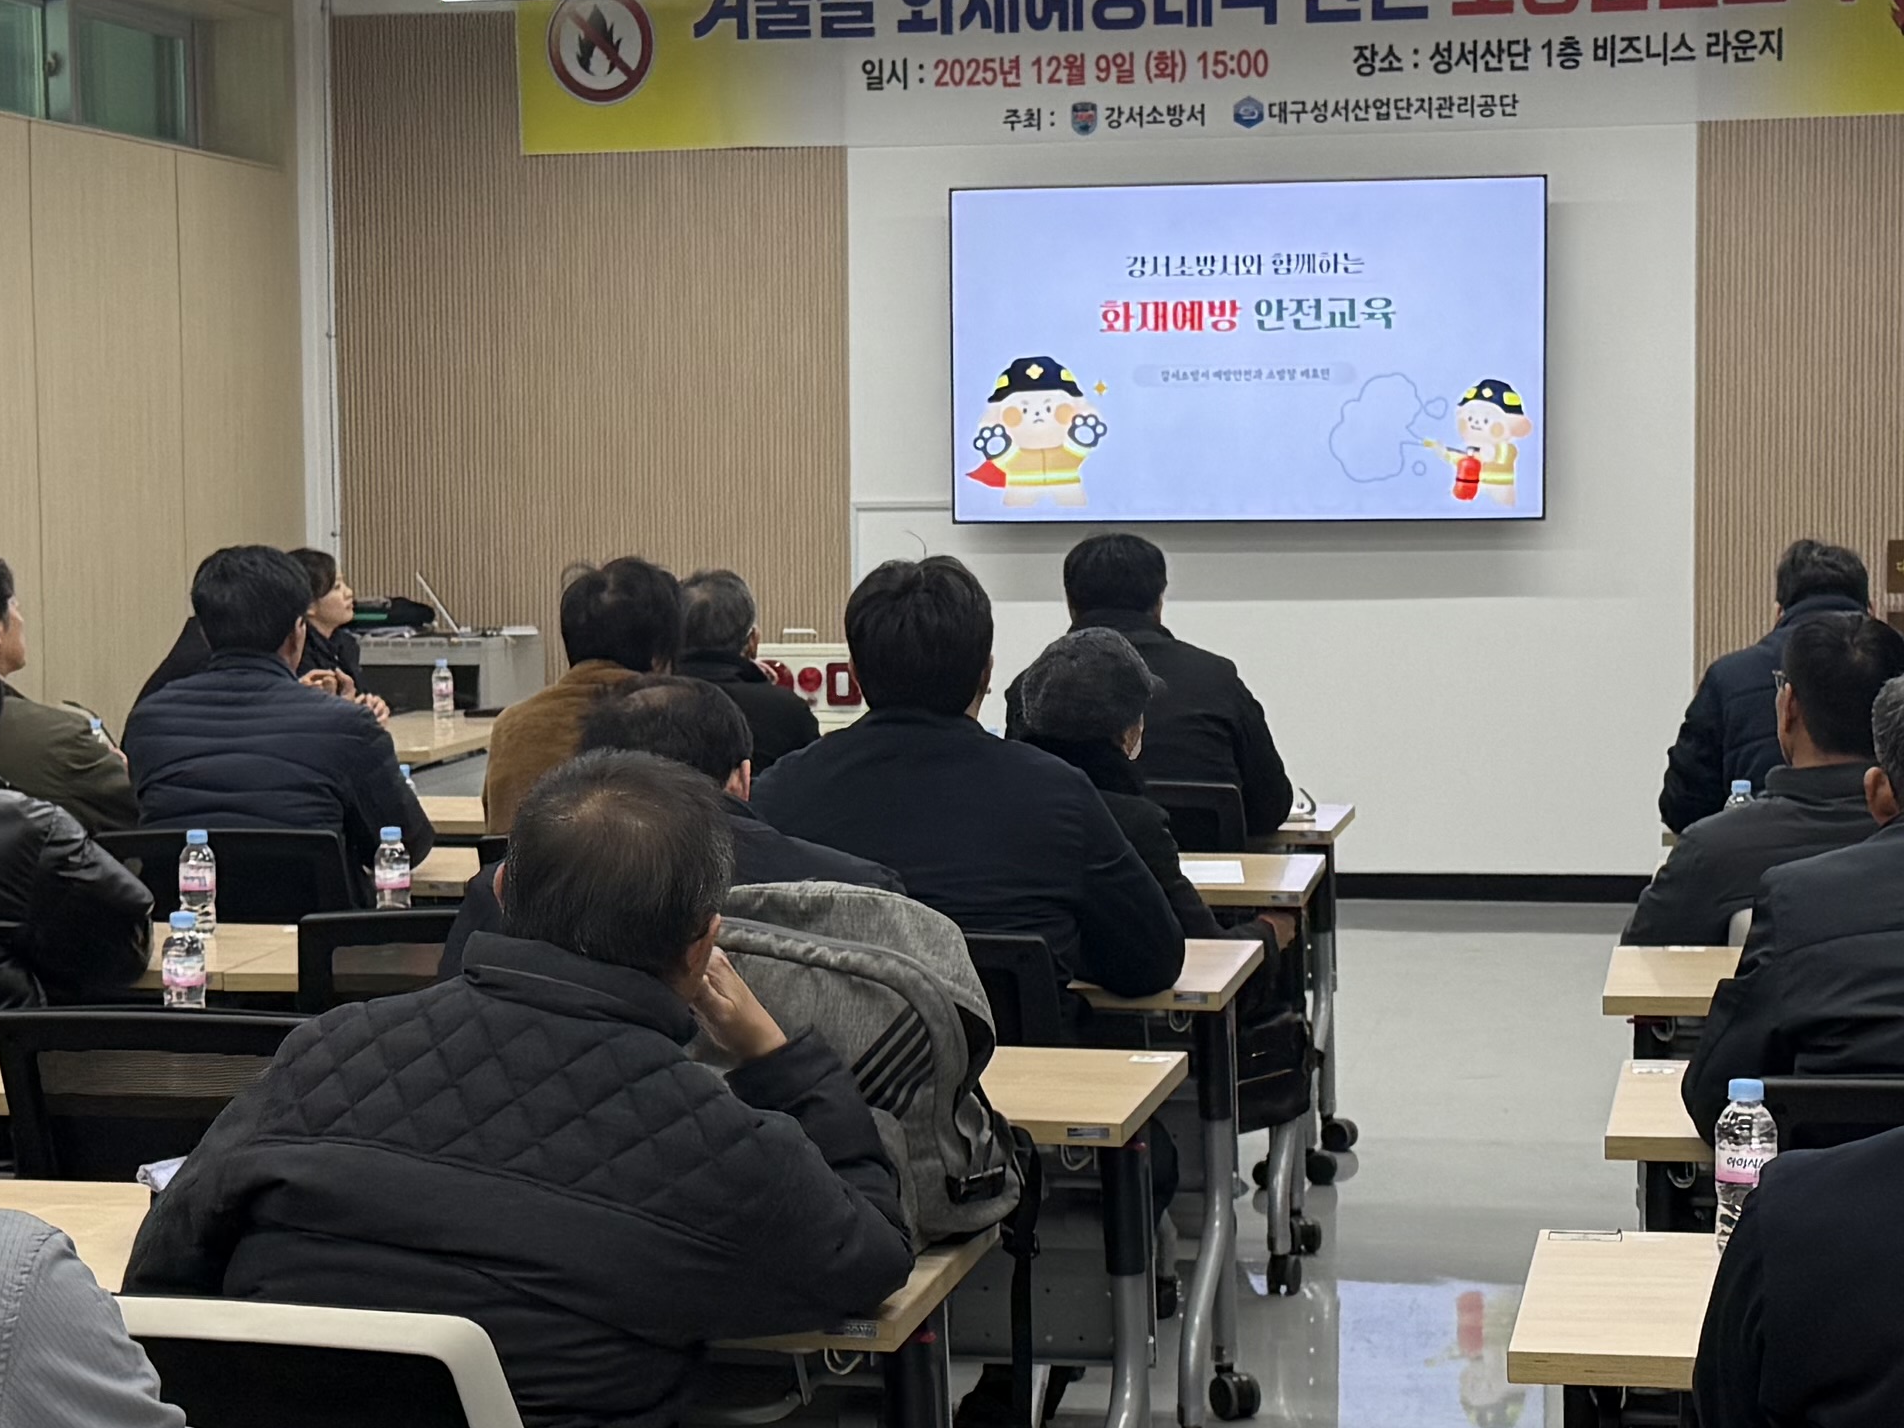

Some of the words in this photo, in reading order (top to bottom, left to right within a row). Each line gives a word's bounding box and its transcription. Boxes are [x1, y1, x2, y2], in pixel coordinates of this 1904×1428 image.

[1352, 42, 1404, 77] 장소
[1428, 37, 1532, 75] 성서산단
[1540, 35, 1584, 70] 1층
[1592, 31, 1697, 69] 비즈니스
[1706, 25, 1784, 64] 라운지
[861, 57, 908, 91] 일시
[933, 54, 1022, 88] 2025년
[1030, 51, 1086, 87] 12월
[1094, 50, 1135, 85] 9일
[1144, 48, 1187, 85] (화)
[1196, 48, 1269, 80] 15:00
[1002, 107, 1042, 132] 주최
[1104, 102, 1206, 130] 강서소방서
[1267, 92, 1520, 125] 대구성서산업단지관리공단
[1126, 254, 1264, 279] 강서소방서와
[1271, 252, 1365, 276] 함께하는
[1099, 299, 1242, 333] 화재예방
[1254, 297, 1397, 332] 안전교육
